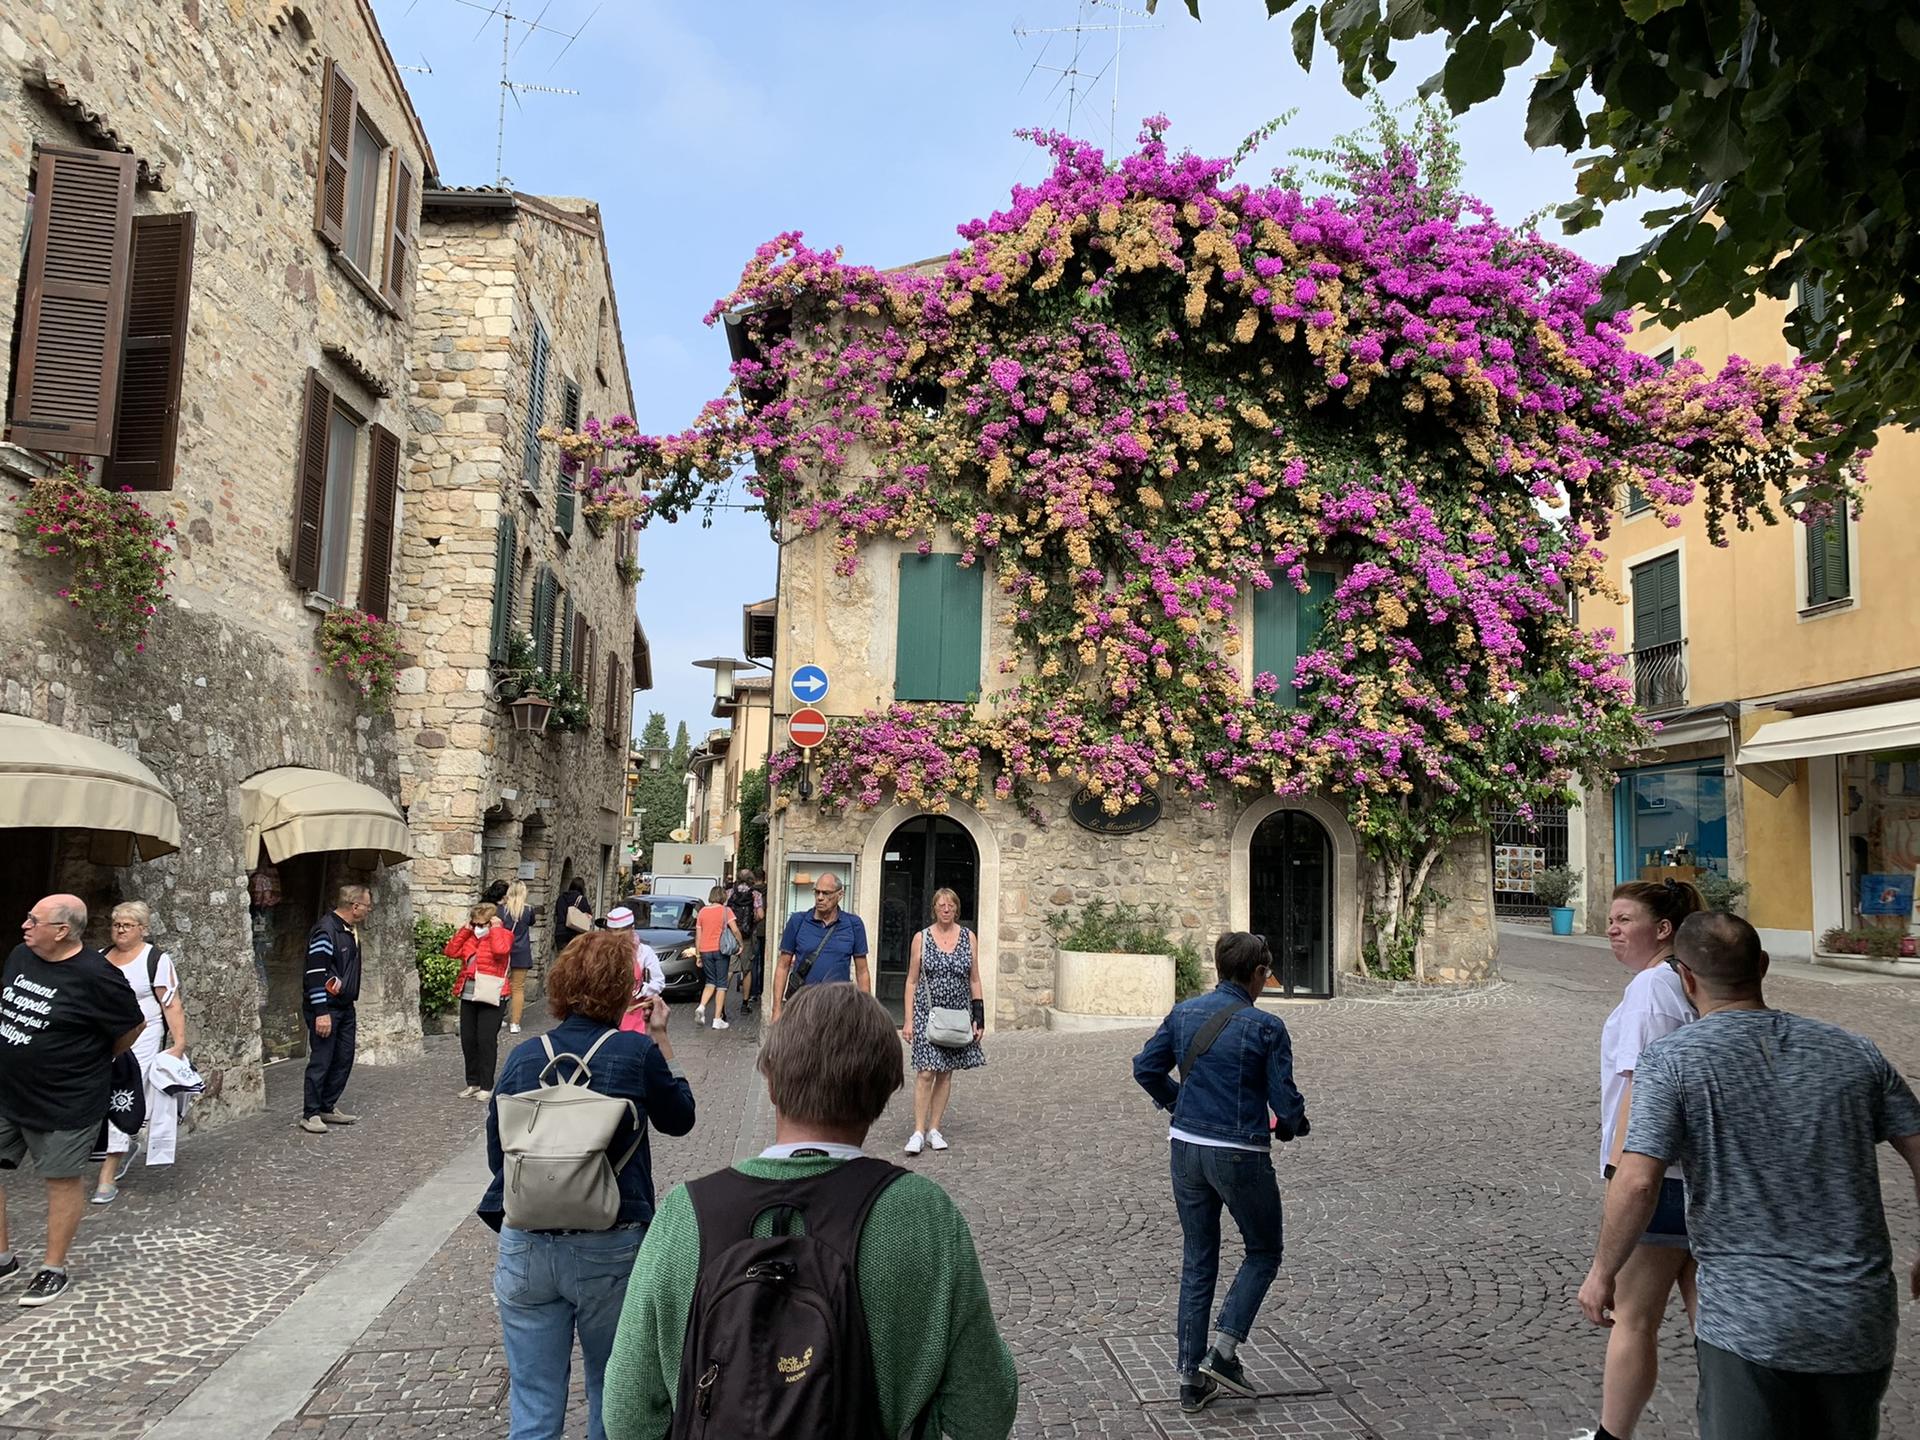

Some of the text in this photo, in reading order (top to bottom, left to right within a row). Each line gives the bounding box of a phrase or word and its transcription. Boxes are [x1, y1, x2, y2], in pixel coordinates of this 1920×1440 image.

[13, 973, 58, 998] Comment
[2, 986, 16, 1002] On
[13, 995, 52, 1015] appelle
[3, 1008, 17, 1018] mec
